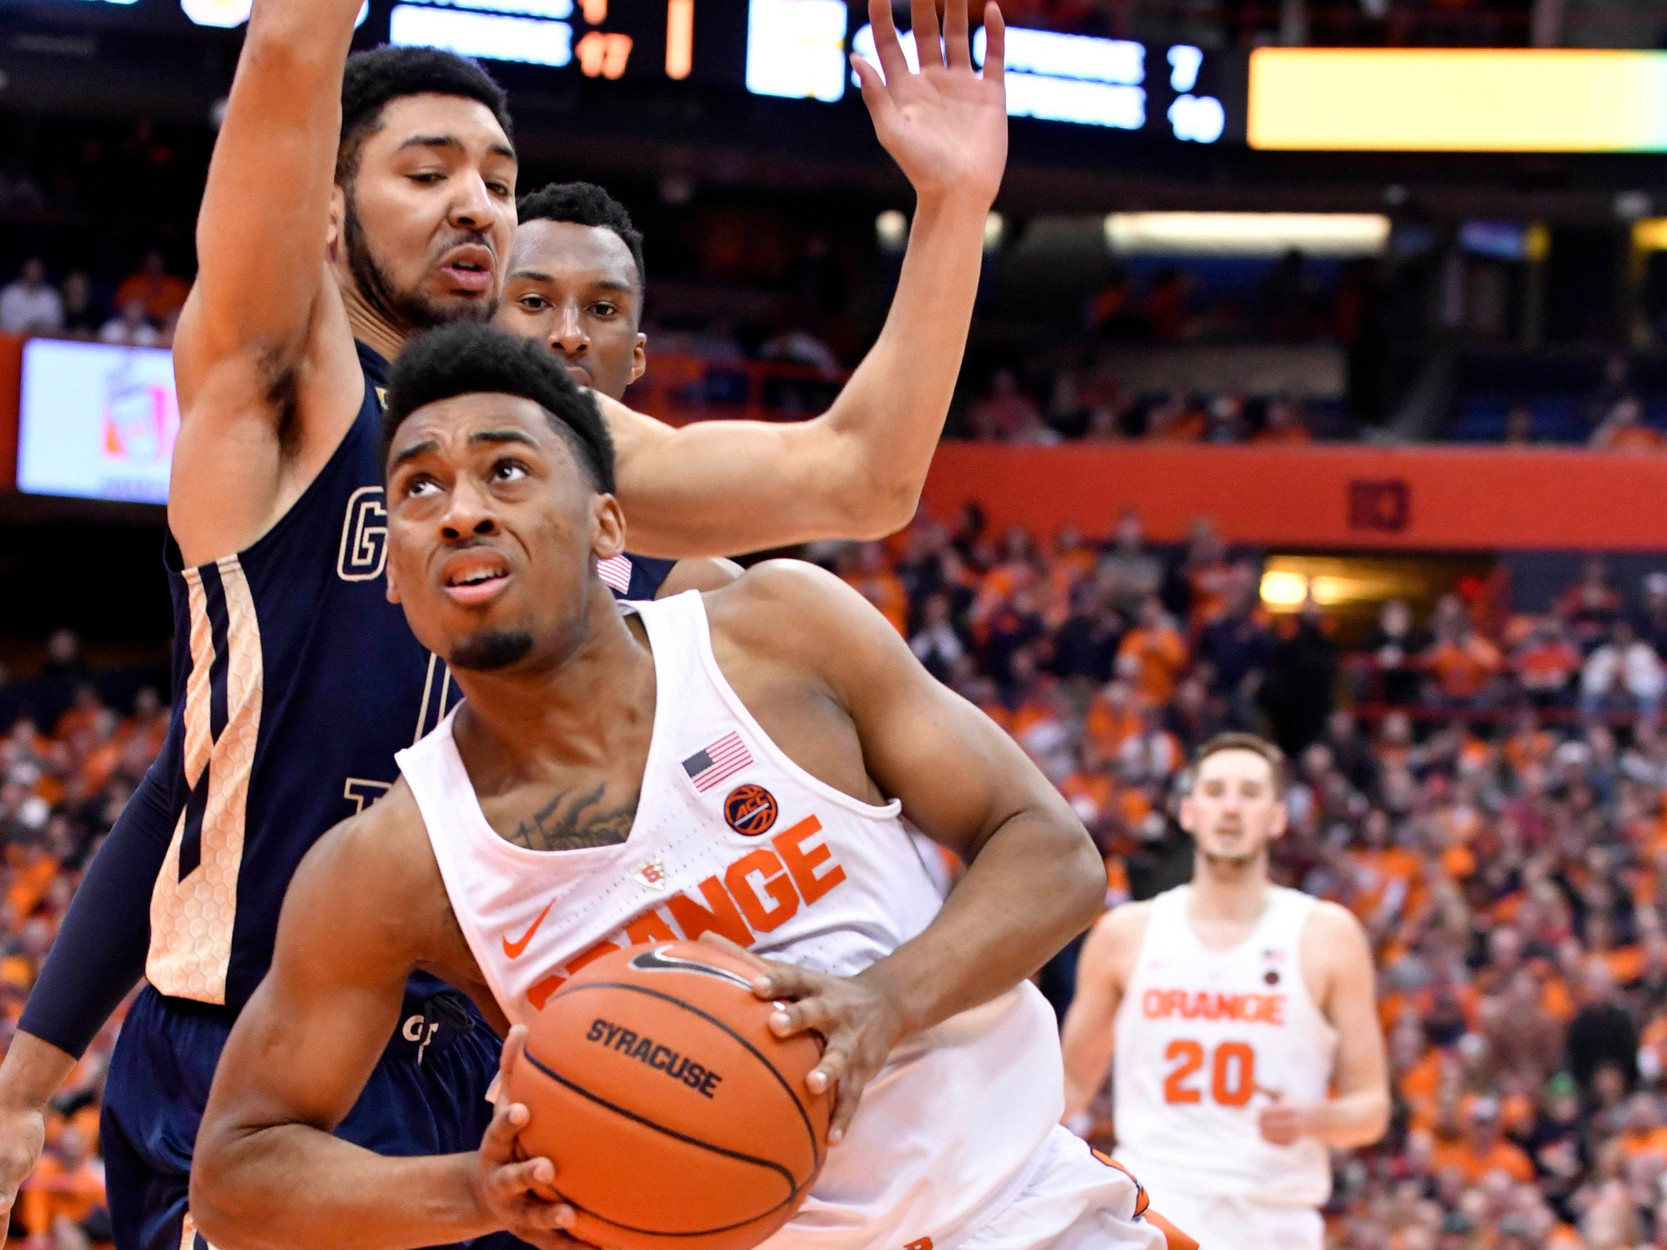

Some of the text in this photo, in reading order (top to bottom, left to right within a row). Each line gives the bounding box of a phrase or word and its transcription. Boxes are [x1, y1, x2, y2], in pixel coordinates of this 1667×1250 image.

[1143, 988, 1286, 1026] ORANGE
[585, 1018, 723, 1099] SYRACUSE
[1164, 1039, 1254, 1107] 20
